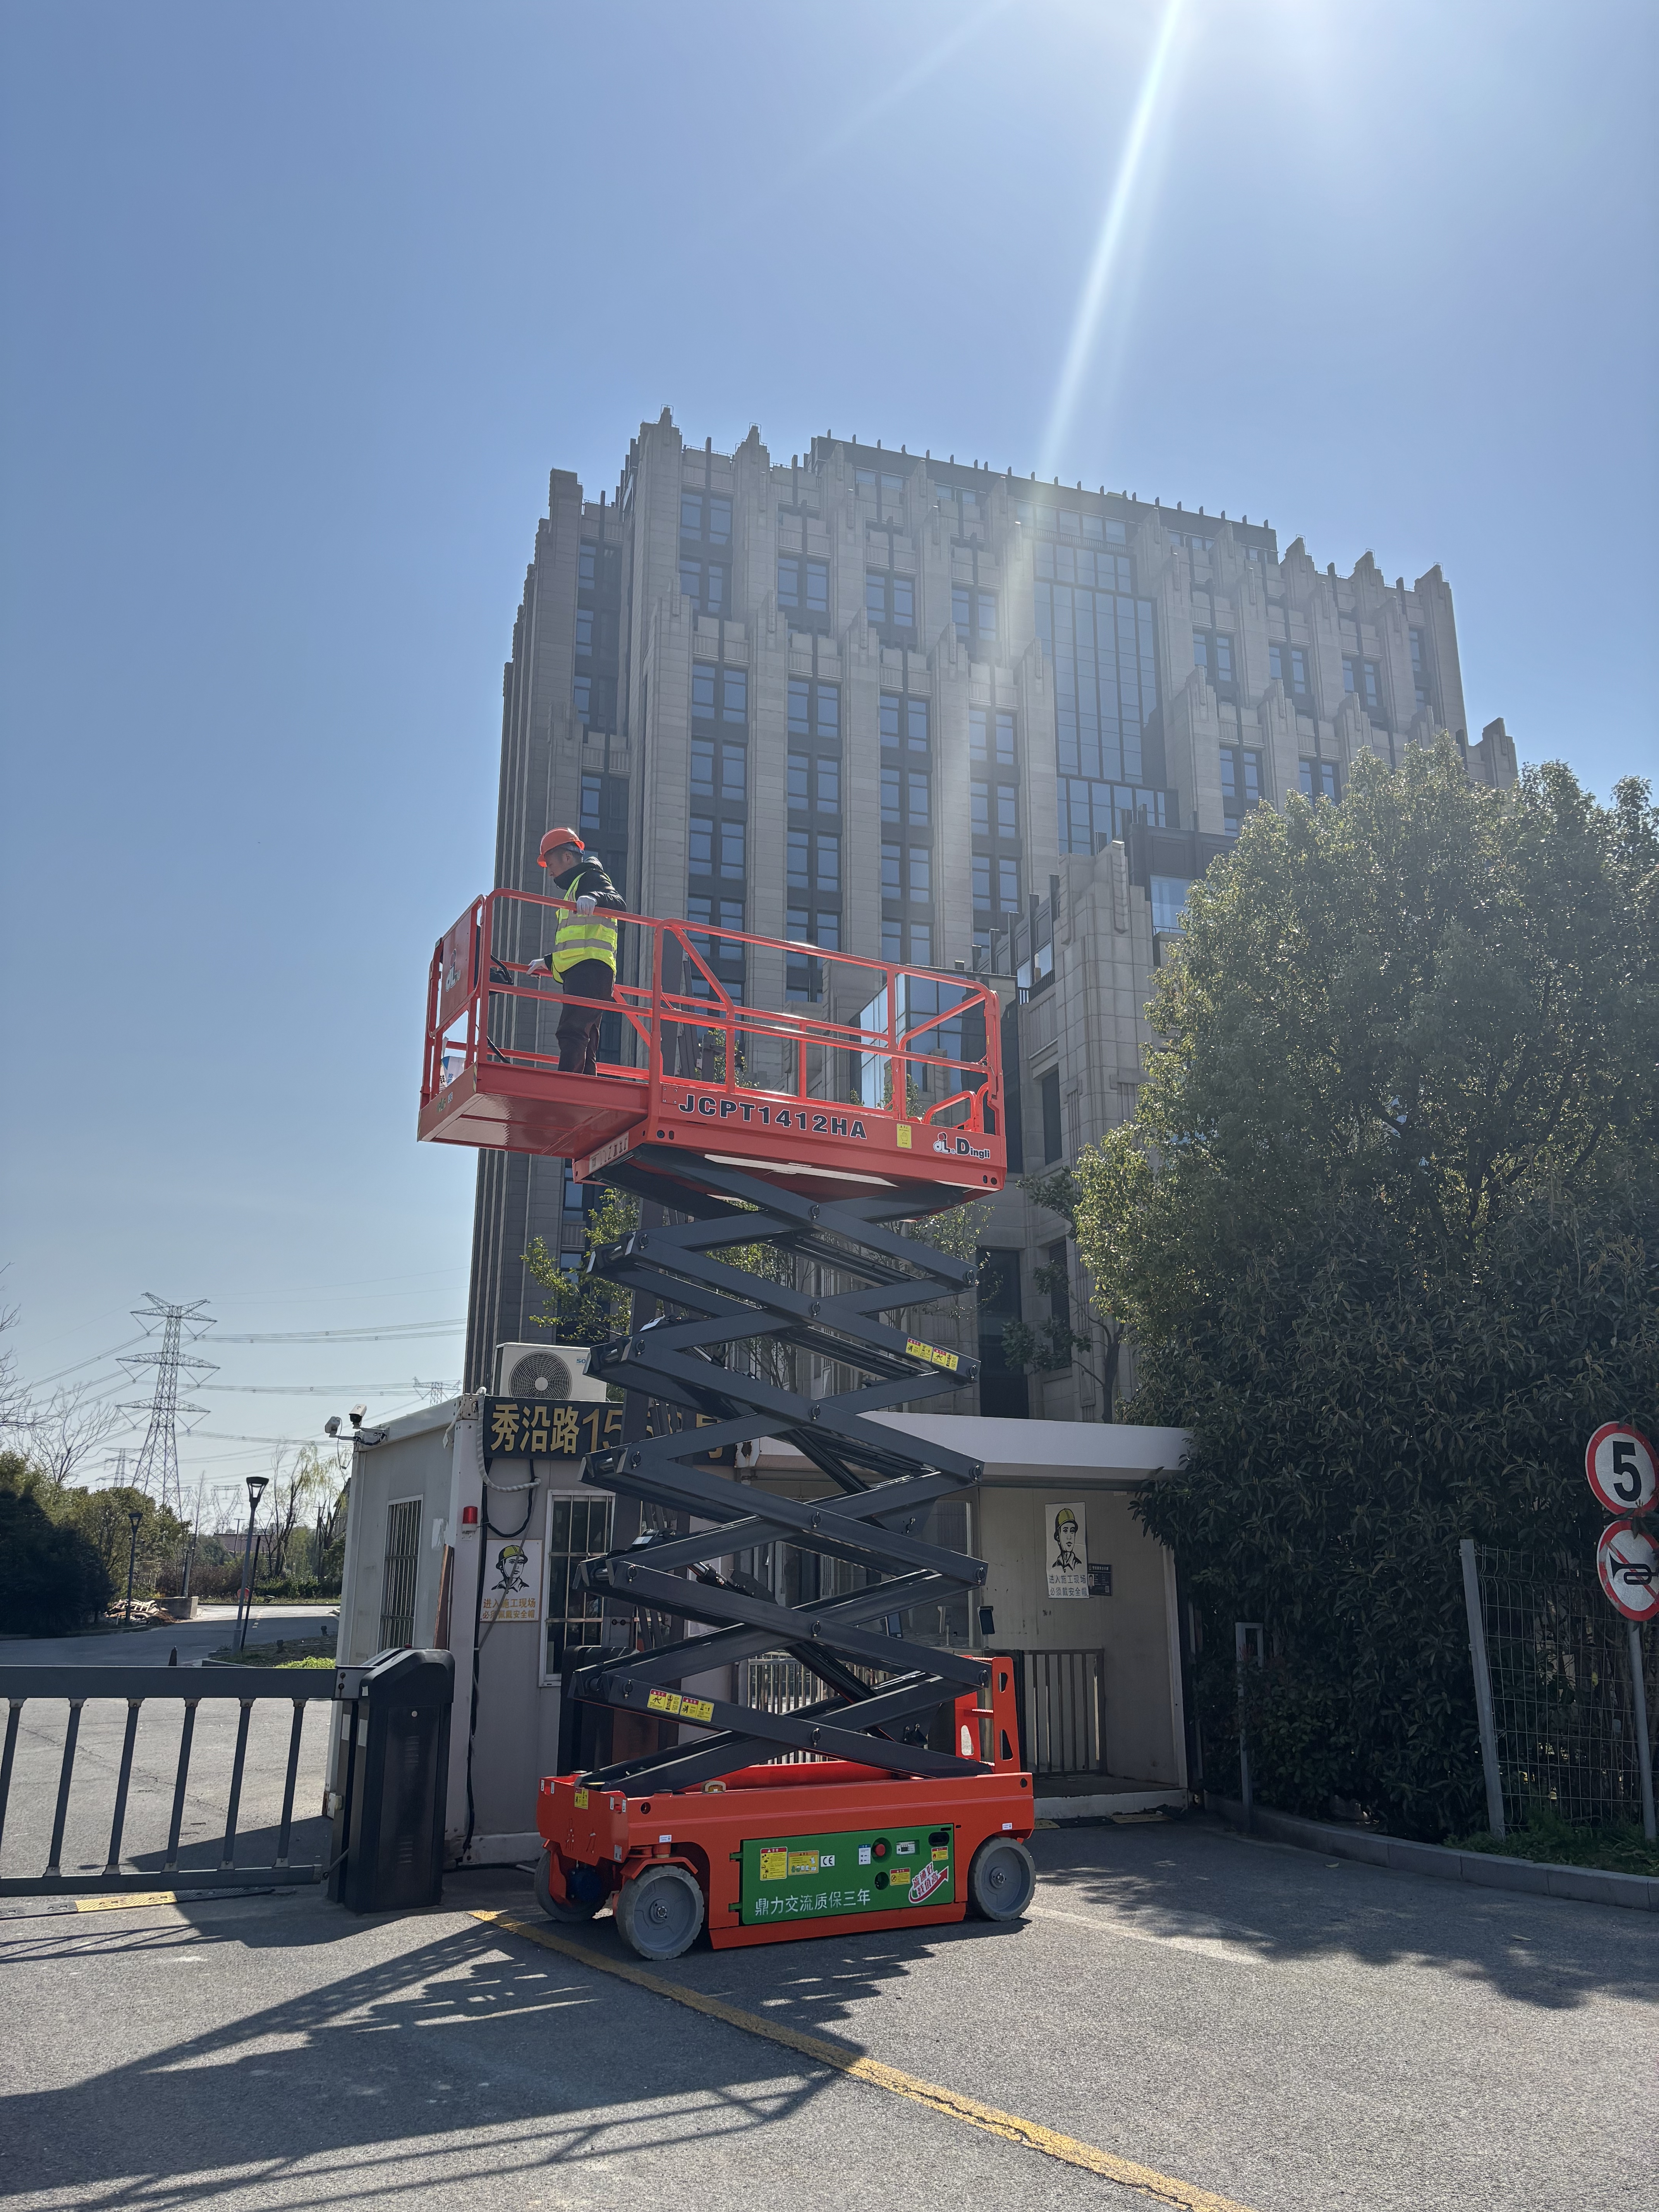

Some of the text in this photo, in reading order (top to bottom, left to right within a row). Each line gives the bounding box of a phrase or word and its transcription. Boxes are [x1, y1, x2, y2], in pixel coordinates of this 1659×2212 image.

[678, 1094, 867, 1139] JCPT1412HA
[956, 1137, 990, 1159] Dingli
[1613, 1441, 1642, 1502] 5
[1049, 1575, 1086, 1583] 进入施工现场
[484, 1598, 536, 1608] 进入施工现场
[1050, 1587, 1087, 1596] 必须戴安全帽
[913, 1863, 933, 1889] 流通好
[755, 1889, 871, 1916] 鼎力交流质保三年
